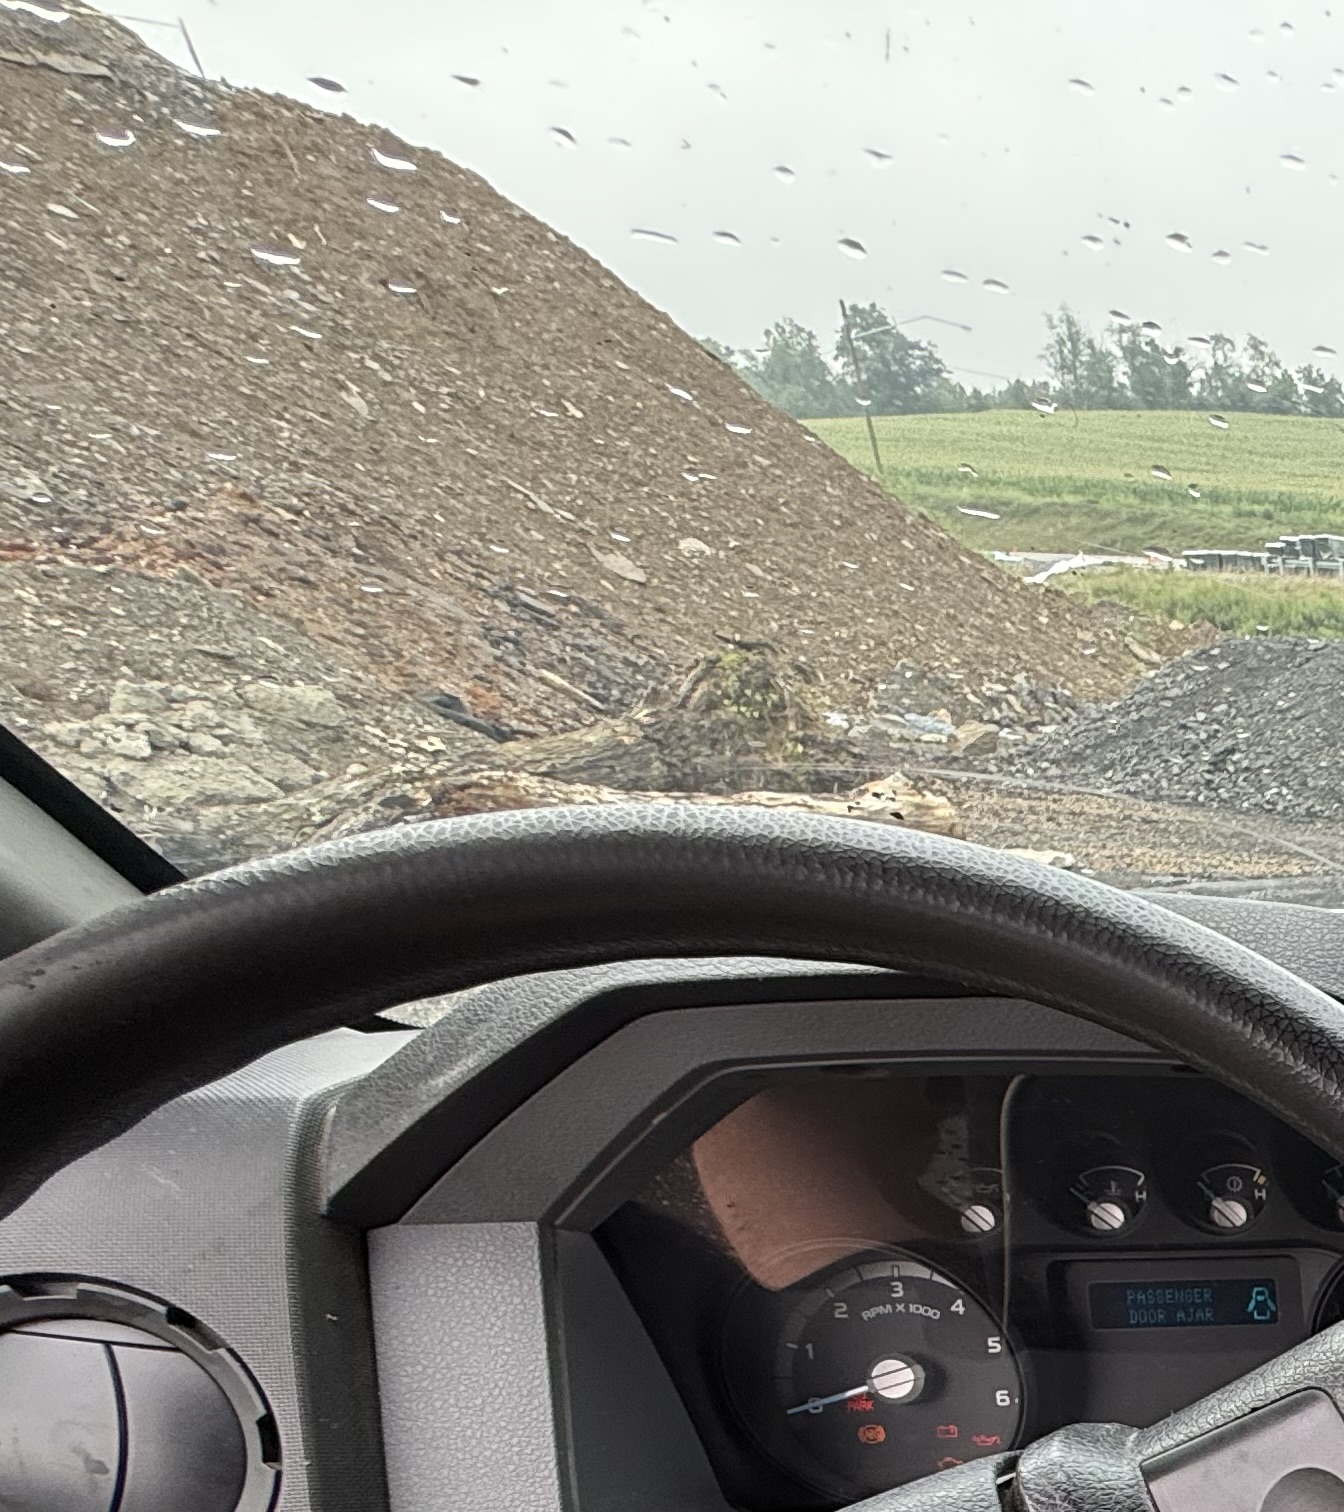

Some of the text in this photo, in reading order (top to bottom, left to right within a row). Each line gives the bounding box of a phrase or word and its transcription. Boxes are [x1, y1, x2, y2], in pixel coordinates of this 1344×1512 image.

[1135, 1189, 1147, 1201] H
[1254, 1187, 1267, 1200] H
[891, 1281, 904, 1298] 3
[1126, 1288, 1213, 1305] PASSENGER
[834, 1303, 848, 1318] 2
[861, 1303, 941, 1322] RPM X 1000
[950, 1299, 966, 1315] 4
[1129, 1308, 1214, 1324] DOOR AJAR
[805, 1343, 814, 1359] 1
[987, 1336, 1002, 1353] 5
[995, 1389, 1011, 1406] 6
